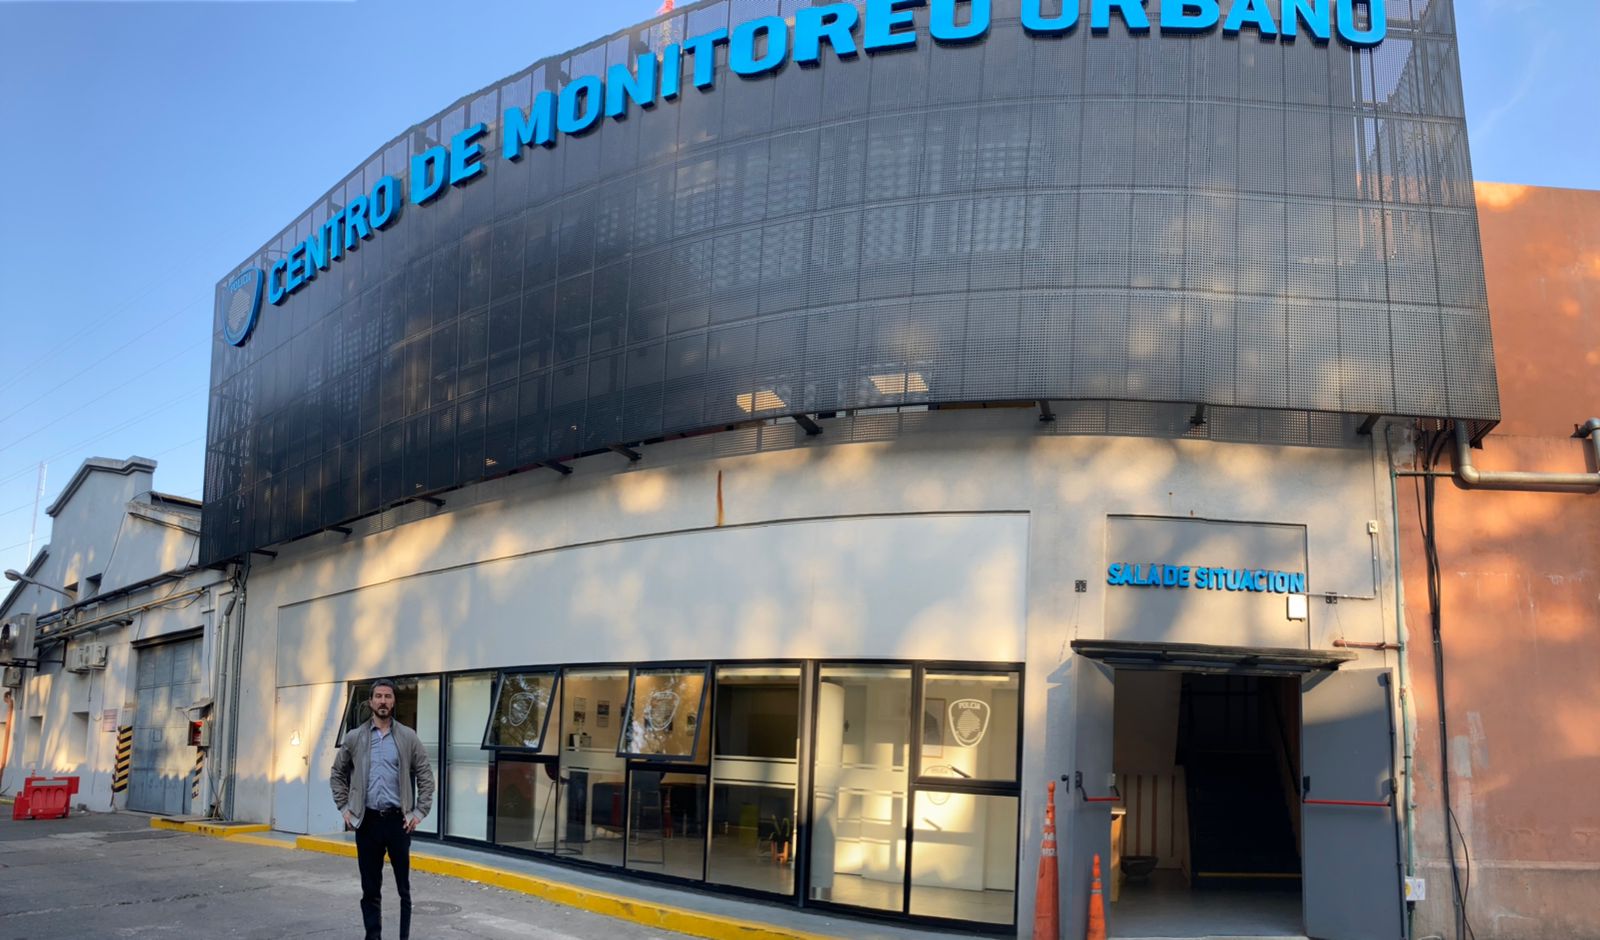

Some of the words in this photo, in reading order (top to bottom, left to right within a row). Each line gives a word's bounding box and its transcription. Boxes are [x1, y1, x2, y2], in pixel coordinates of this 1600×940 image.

[267, 175, 402, 307] CENTRO
[410, 122, 488, 206] DE
[503, 0, 992, 160] MONITOREO
[1107, 562, 1160, 586] SALA
[1162, 564, 1190, 588] DE
[1195, 566, 1304, 593] SITUACION
